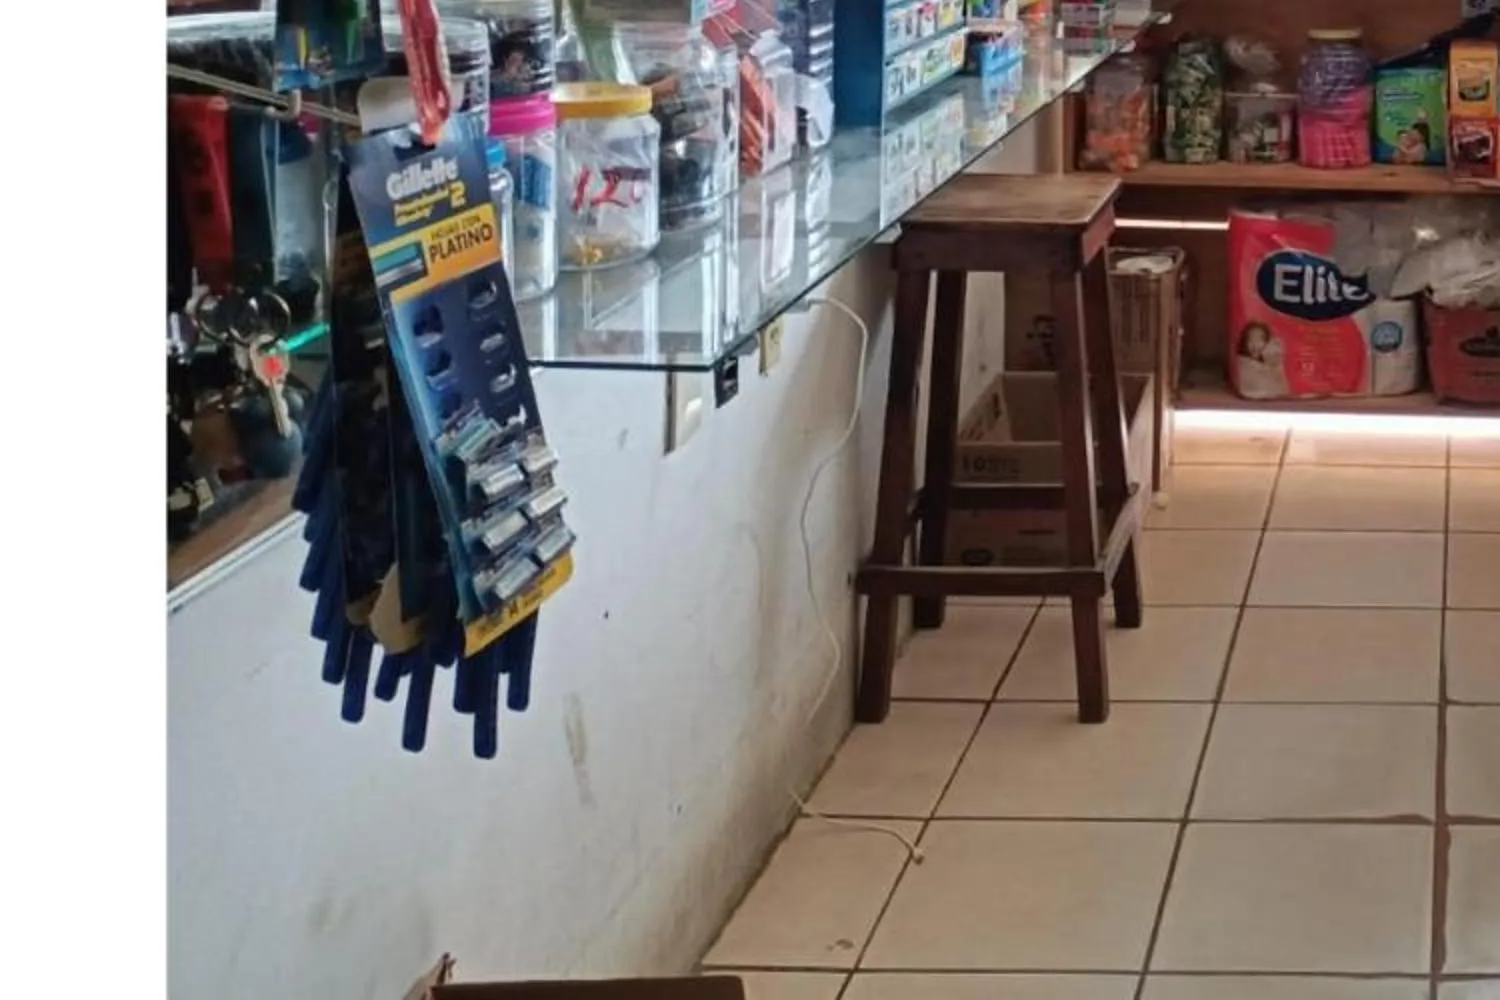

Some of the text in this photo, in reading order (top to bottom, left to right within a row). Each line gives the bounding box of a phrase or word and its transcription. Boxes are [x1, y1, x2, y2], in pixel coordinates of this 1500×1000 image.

[386, 156, 459, 201] Gillette
[429, 223, 494, 264] PLATINO
[1273, 263, 1369, 305] Elite
